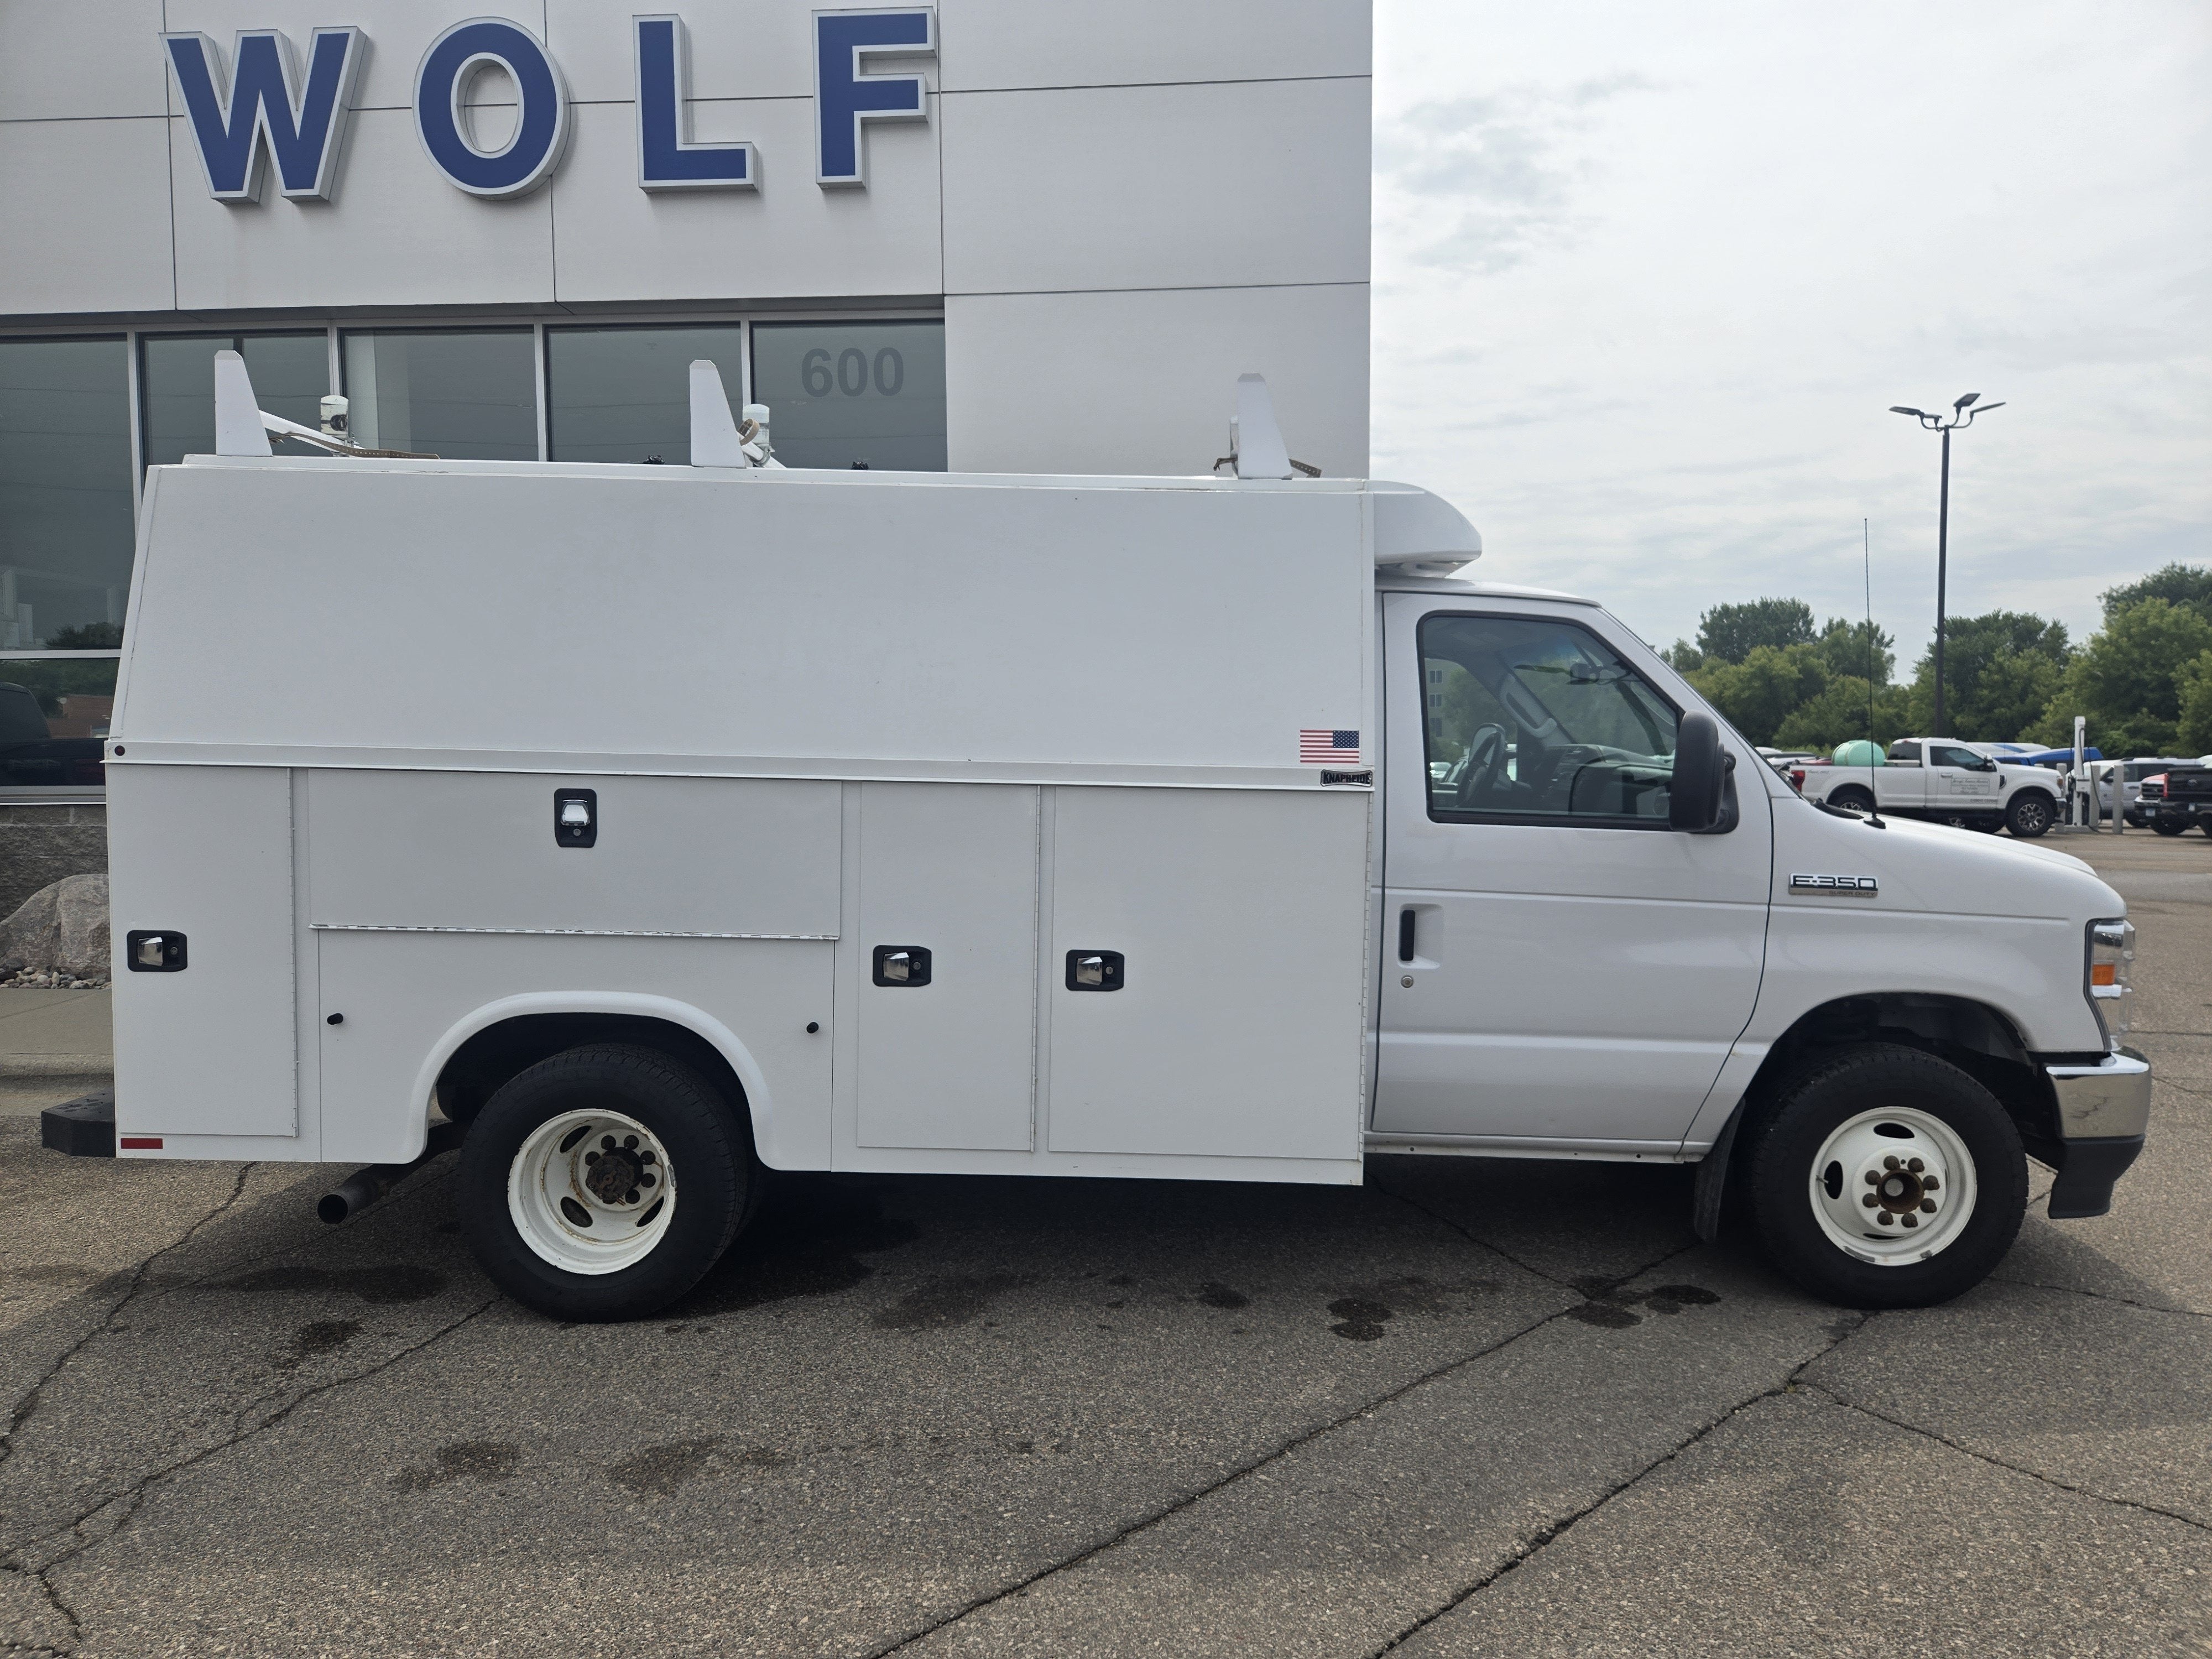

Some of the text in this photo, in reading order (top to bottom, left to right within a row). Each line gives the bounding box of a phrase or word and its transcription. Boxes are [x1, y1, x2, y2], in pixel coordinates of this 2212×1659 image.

[158, 7, 937, 204] WOLF
[802, 347, 904, 398] 600
[1323, 771, 1372, 784] KNAPHEIDE
